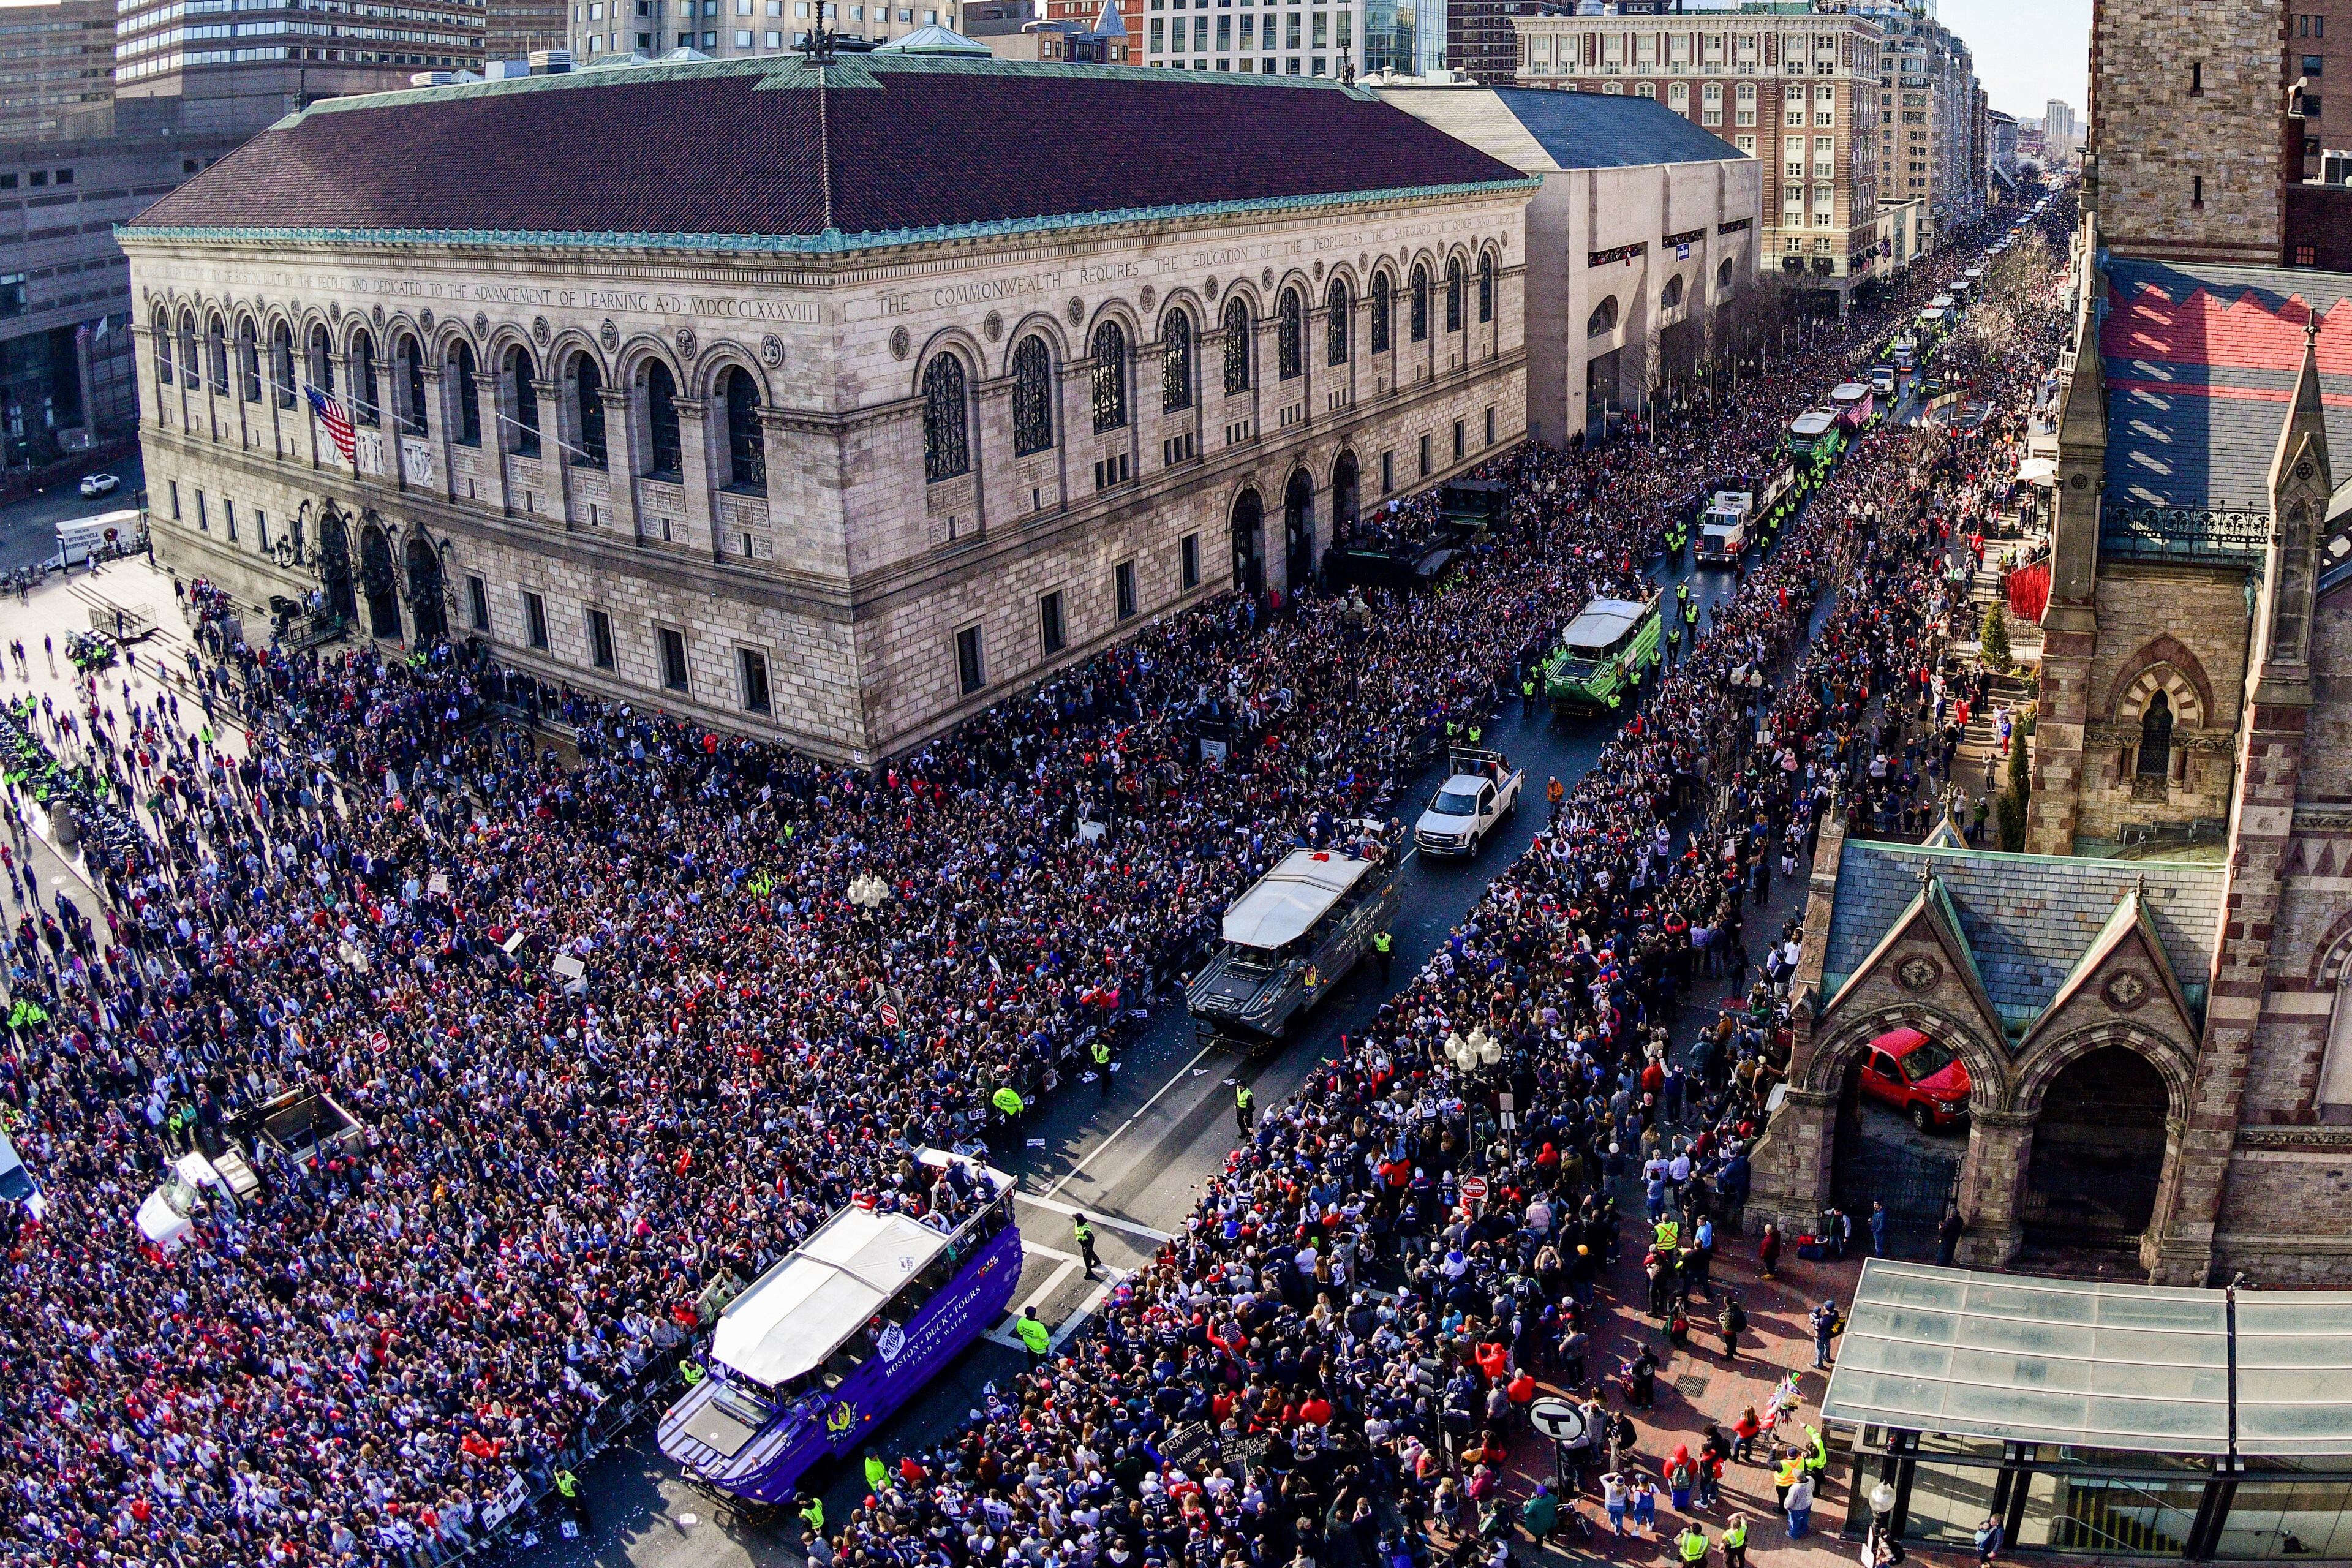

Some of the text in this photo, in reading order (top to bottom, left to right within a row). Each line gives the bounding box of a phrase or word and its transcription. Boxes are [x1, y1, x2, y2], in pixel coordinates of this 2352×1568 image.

[876, 295, 910, 314] THE
[935, 273, 1061, 306] COMMONWEALTH
[1080, 262, 1139, 284] REQUIRES
[1155, 257, 1178, 273] THE
[1193, 247, 1248, 267] EDUCATION
[1260, 244, 1272, 258] OF
[1284, 240, 1302, 254] THE
[1314, 236, 1343, 250] PEOPLE
[1353, 232, 1362, 244] AS
[1372, 228, 1385, 243] THE
[1394, 224, 1431, 239] SAFEGUARD
[1438, 221, 1446, 232] OF
[1452, 219, 1472, 230] ORDER
[1477, 216, 1490, 227] AND
[195, 269, 204, 279] THE
[206, 270, 222, 280] CITY
[224, 270, 232, 282] OF
[235, 271, 260, 284] BOSTON
[263, 273, 281, 285] BUILT
[285, 274, 294, 286] BY
[299, 275, 313, 288] THE
[318, 276, 345, 290] PEOPLE
[350, 279, 368, 292] AND
[374, 280, 422, 295] DEDICATED
[430, 283, 442, 296] TO
[448, 284, 467, 298] THE
[474, 286, 551, 304] ADVANCEMENT
[560, 291, 575, 306] OF
[584, 292, 647, 311] LEARNING
[1335, 933, 1353, 955] BOSTON
[1356, 919, 1368, 933] DUCK
[1371, 901, 1384, 918] TOURS
[1346, 939, 1357, 952] LAND
[1441, 960, 1453, 970] 12
[886, 1286, 981, 1378] BOSTON DUCK TOURS
[1285, 1325, 1295, 1336] 12
[912, 1345, 932, 1366] LAND
[944, 1312, 968, 1336] WATER
[1198, 1359, 1205, 1369] 12
[1536, 1411, 1570, 1436] T
[1219, 1434, 1238, 1444] LIKE,
[1222, 1434, 1268, 1451] THE BENGALS
[1223, 1447, 1266, 1462] ACTUALLY EXIST
[1153, 1504, 1167, 1513] 75
[989, 1512, 1007, 1523] 81
[1194, 1548, 1205, 1558] 12
